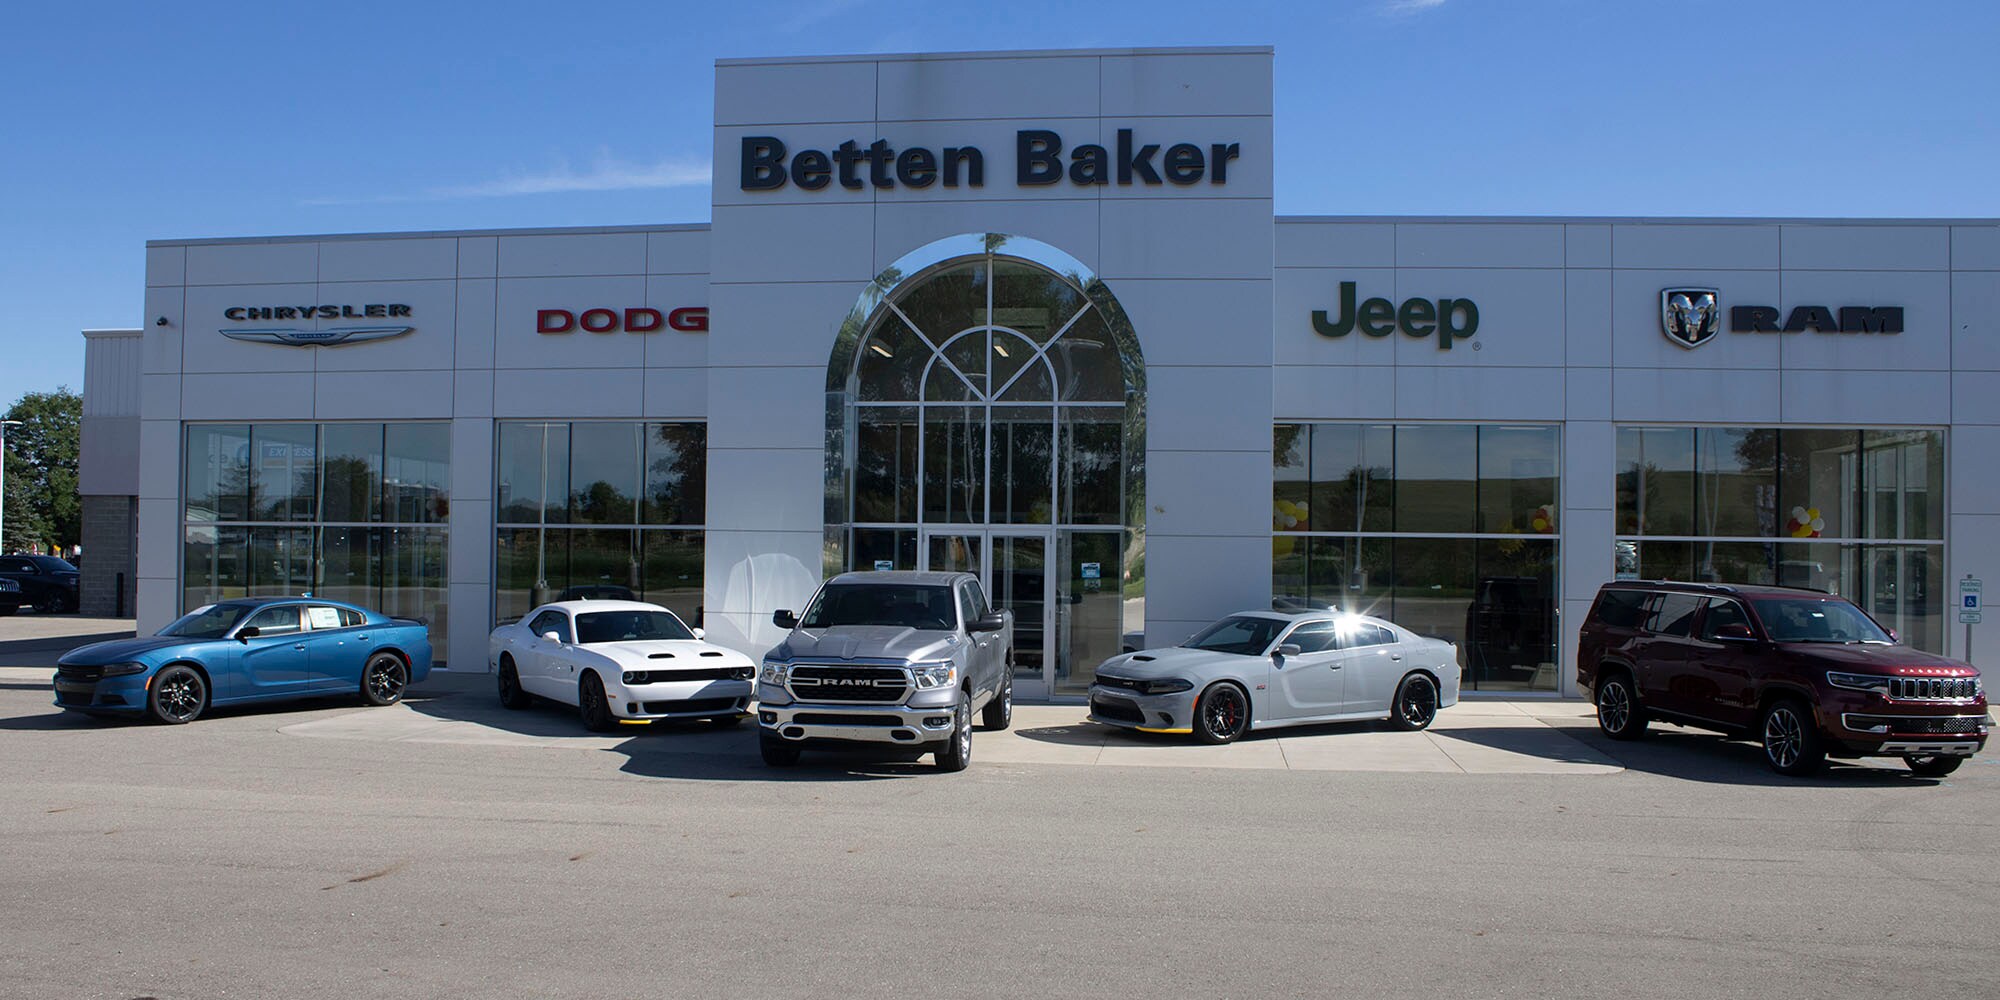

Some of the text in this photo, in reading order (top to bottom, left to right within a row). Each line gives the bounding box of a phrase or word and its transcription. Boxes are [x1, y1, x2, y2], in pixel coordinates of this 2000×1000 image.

[741, 128, 1240, 191] Betten Baker
[224, 304, 412, 321] CHRYSLER
[1312, 281, 1479, 350] Jeep
[1731, 305, 1904, 333] RAM
